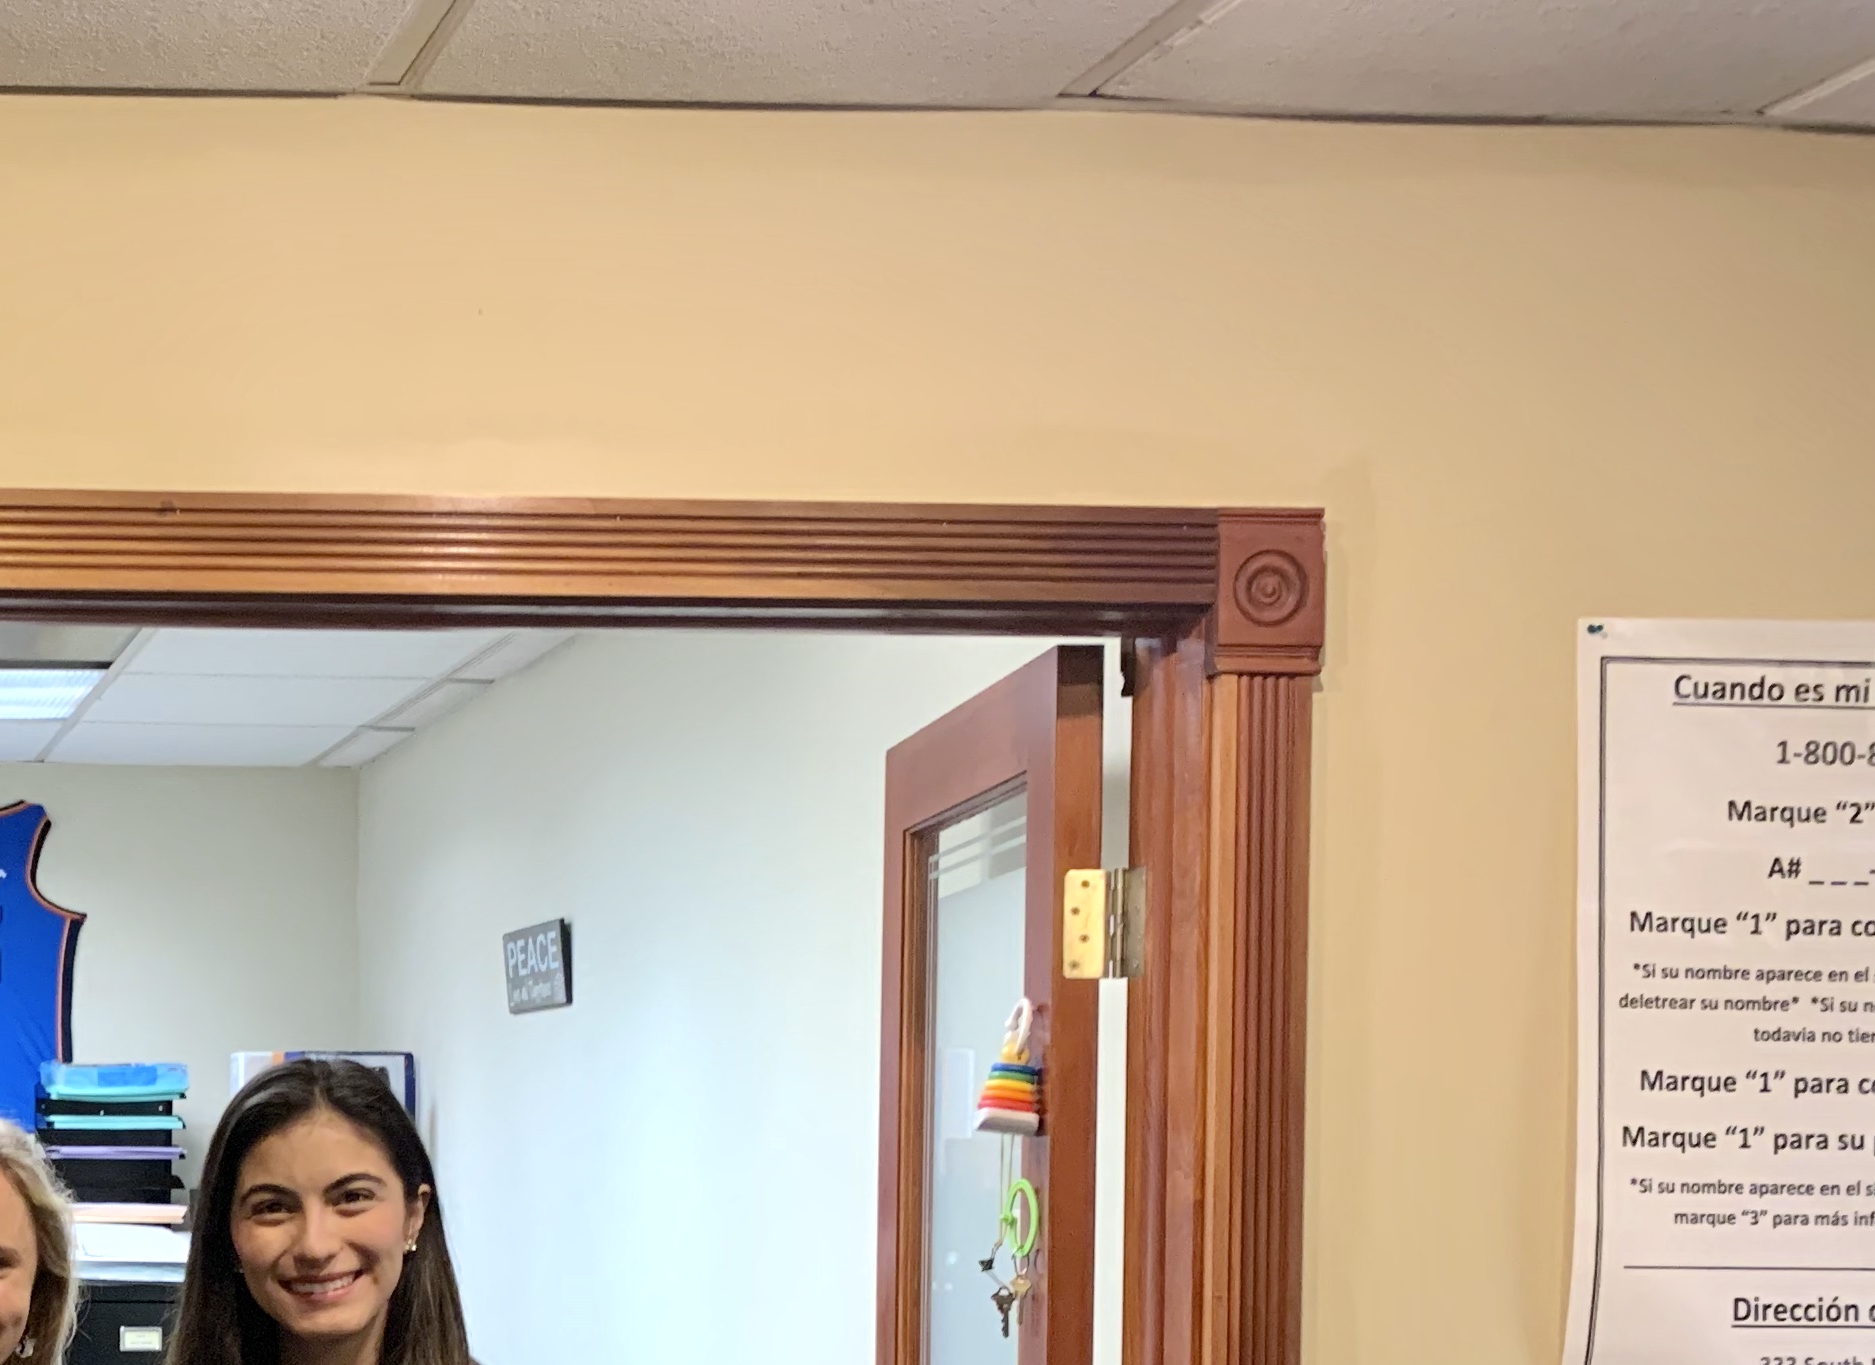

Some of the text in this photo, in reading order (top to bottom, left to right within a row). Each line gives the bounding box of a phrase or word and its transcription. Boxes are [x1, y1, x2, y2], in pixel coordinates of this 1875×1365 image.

[1673, 673, 1871, 704] Cuando es mi
[1727, 799, 1828, 829] Marque
[1767, 856, 1802, 880] A#
[1629, 910, 1729, 940] Marque
[1784, 918, 1843, 942] para
[506, 931, 560, 979] PEACE
[1660, 967, 1680, 980] su
[1684, 964, 1751, 981] nombre
[1754, 968, 1824, 985] aparece
[1827, 969, 1849, 983] en
[1853, 966, 1870, 983] el
[1618, 992, 1697, 1010] deletrear
[1700, 998, 1719, 1011] su
[1839, 1000, 1859, 1014] su
[1862, 1001, 1875, 1013] n
[1820, 1030, 1843, 1044] no
[1640, 1069, 1738, 1099] Marque
[1793, 1076, 1850, 1100] para
[1622, 1125, 1717, 1154] Marque
[1773, 1132, 1830, 1156] para
[1837, 1133, 1865, 1151] su
[1657, 1181, 1676, 1195] su
[1680, 1178, 1745, 1195] nombre
[1748, 1182, 1816, 1199] aparece
[1819, 1184, 1841, 1197] en
[1845, 1179, 1862, 1197] el
[1673, 1212, 1737, 1229] marque
[1772, 1213, 1810, 1230] para
[1813, 1210, 1849, 1227] más
[1732, 1295, 1860, 1323] Dirección
